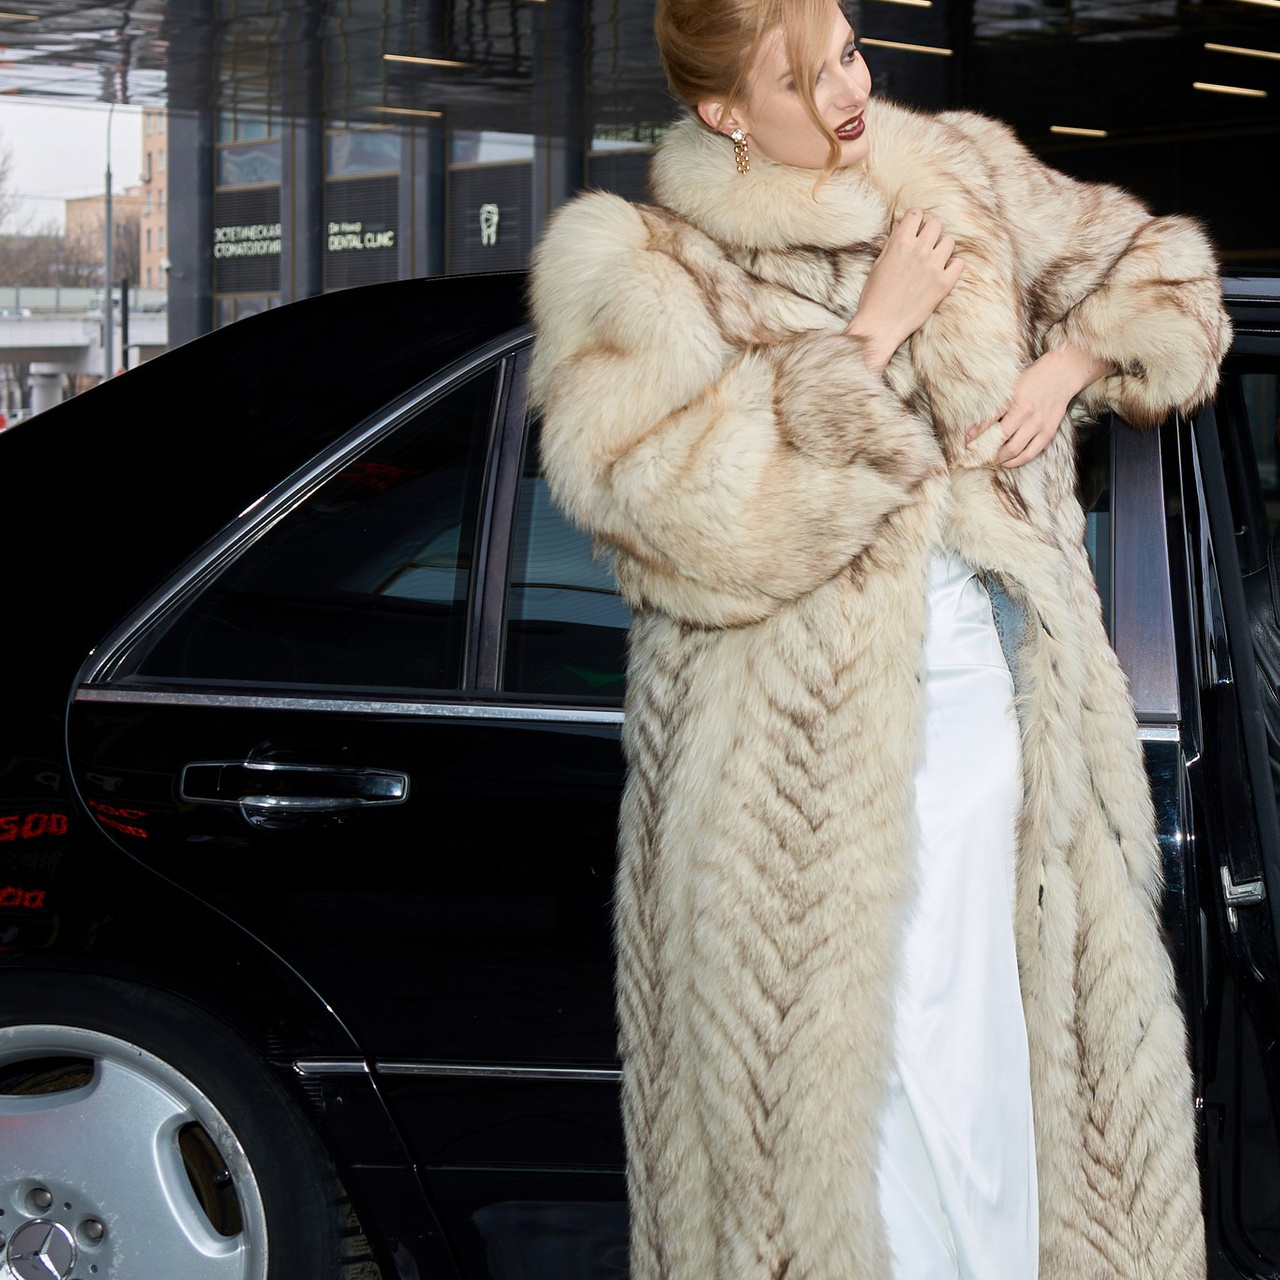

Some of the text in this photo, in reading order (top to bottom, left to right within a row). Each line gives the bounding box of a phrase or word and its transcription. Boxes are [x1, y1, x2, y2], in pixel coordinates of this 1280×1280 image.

[214, 223, 281, 242] ЭСТЕТИЧЕСКАЯ
[328, 231, 394, 251] DENTAL CLINIC
[214, 238, 281, 258] СТОМАТОЛОГИЯ
